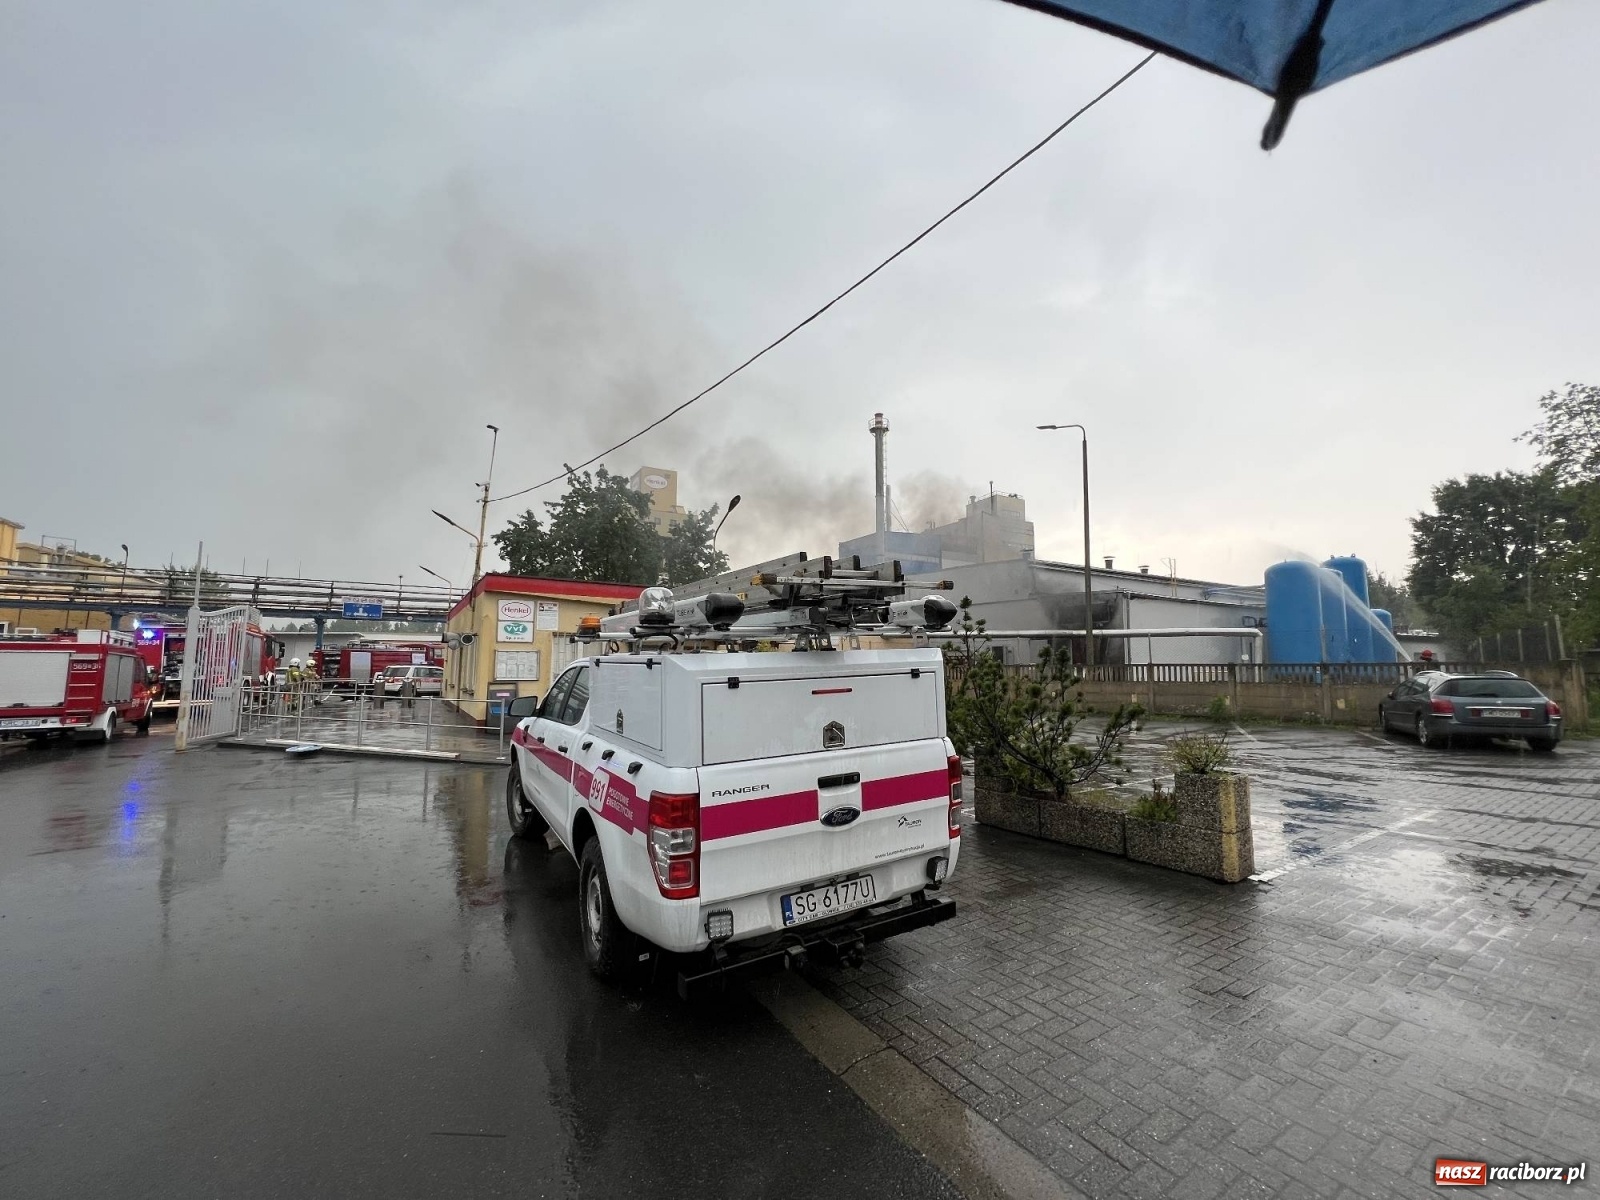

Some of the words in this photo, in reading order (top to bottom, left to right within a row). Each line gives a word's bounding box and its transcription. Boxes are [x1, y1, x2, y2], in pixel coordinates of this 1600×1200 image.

[504, 606, 529, 614] Henkel
[506, 624, 524, 632] vvf
[591, 778, 606, 802] 991
[711, 783, 770, 798] RANGER
[831, 809, 853, 823] Ford
[795, 893, 817, 916] SG
[822, 878, 870, 908] 6177U
